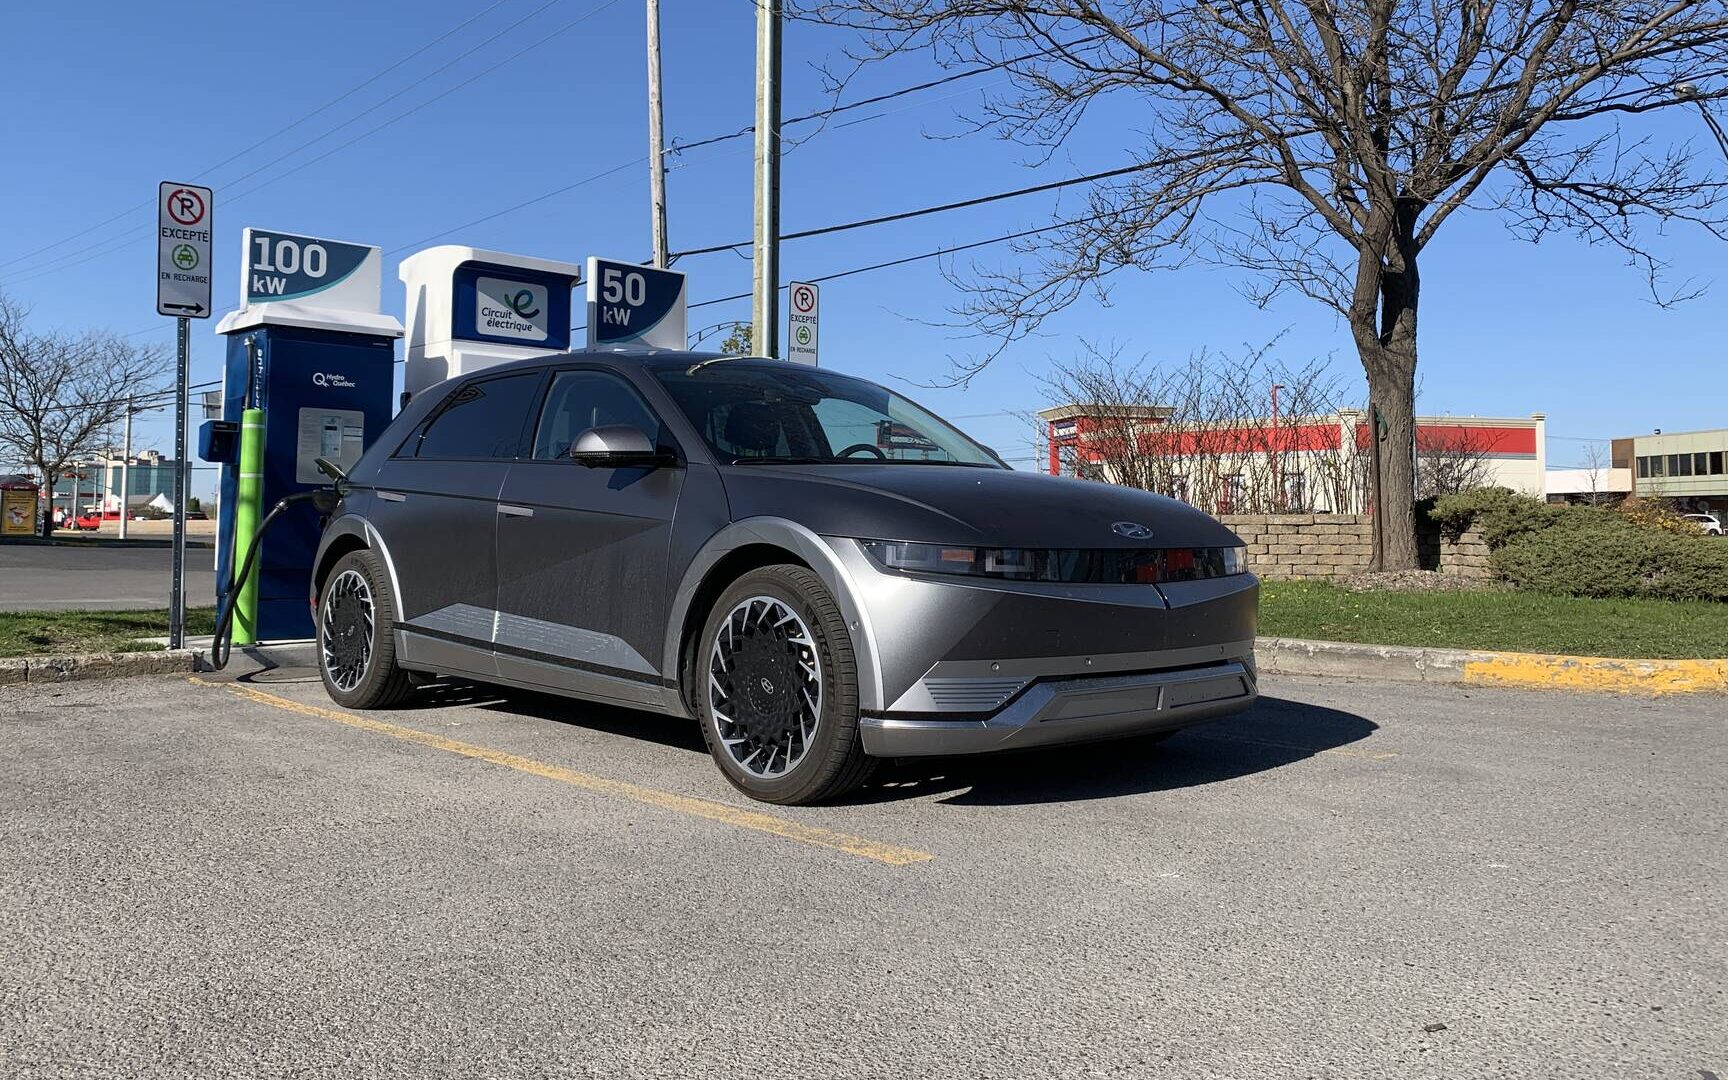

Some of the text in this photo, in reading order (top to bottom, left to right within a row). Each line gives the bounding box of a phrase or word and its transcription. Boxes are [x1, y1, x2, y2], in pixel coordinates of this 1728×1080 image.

[161, 227, 209, 242] EXCEPTÉ
[254, 237, 327, 278] 100
[161, 271, 208, 284] EN RECHARGE
[253, 274, 287, 295] kW
[603, 268, 646, 307] 50
[481, 306, 513, 319] Circuit
[603, 305, 631, 326] kW
[791, 314, 817, 325] EXCEPTÉ
[487, 317, 533, 333] électrique
